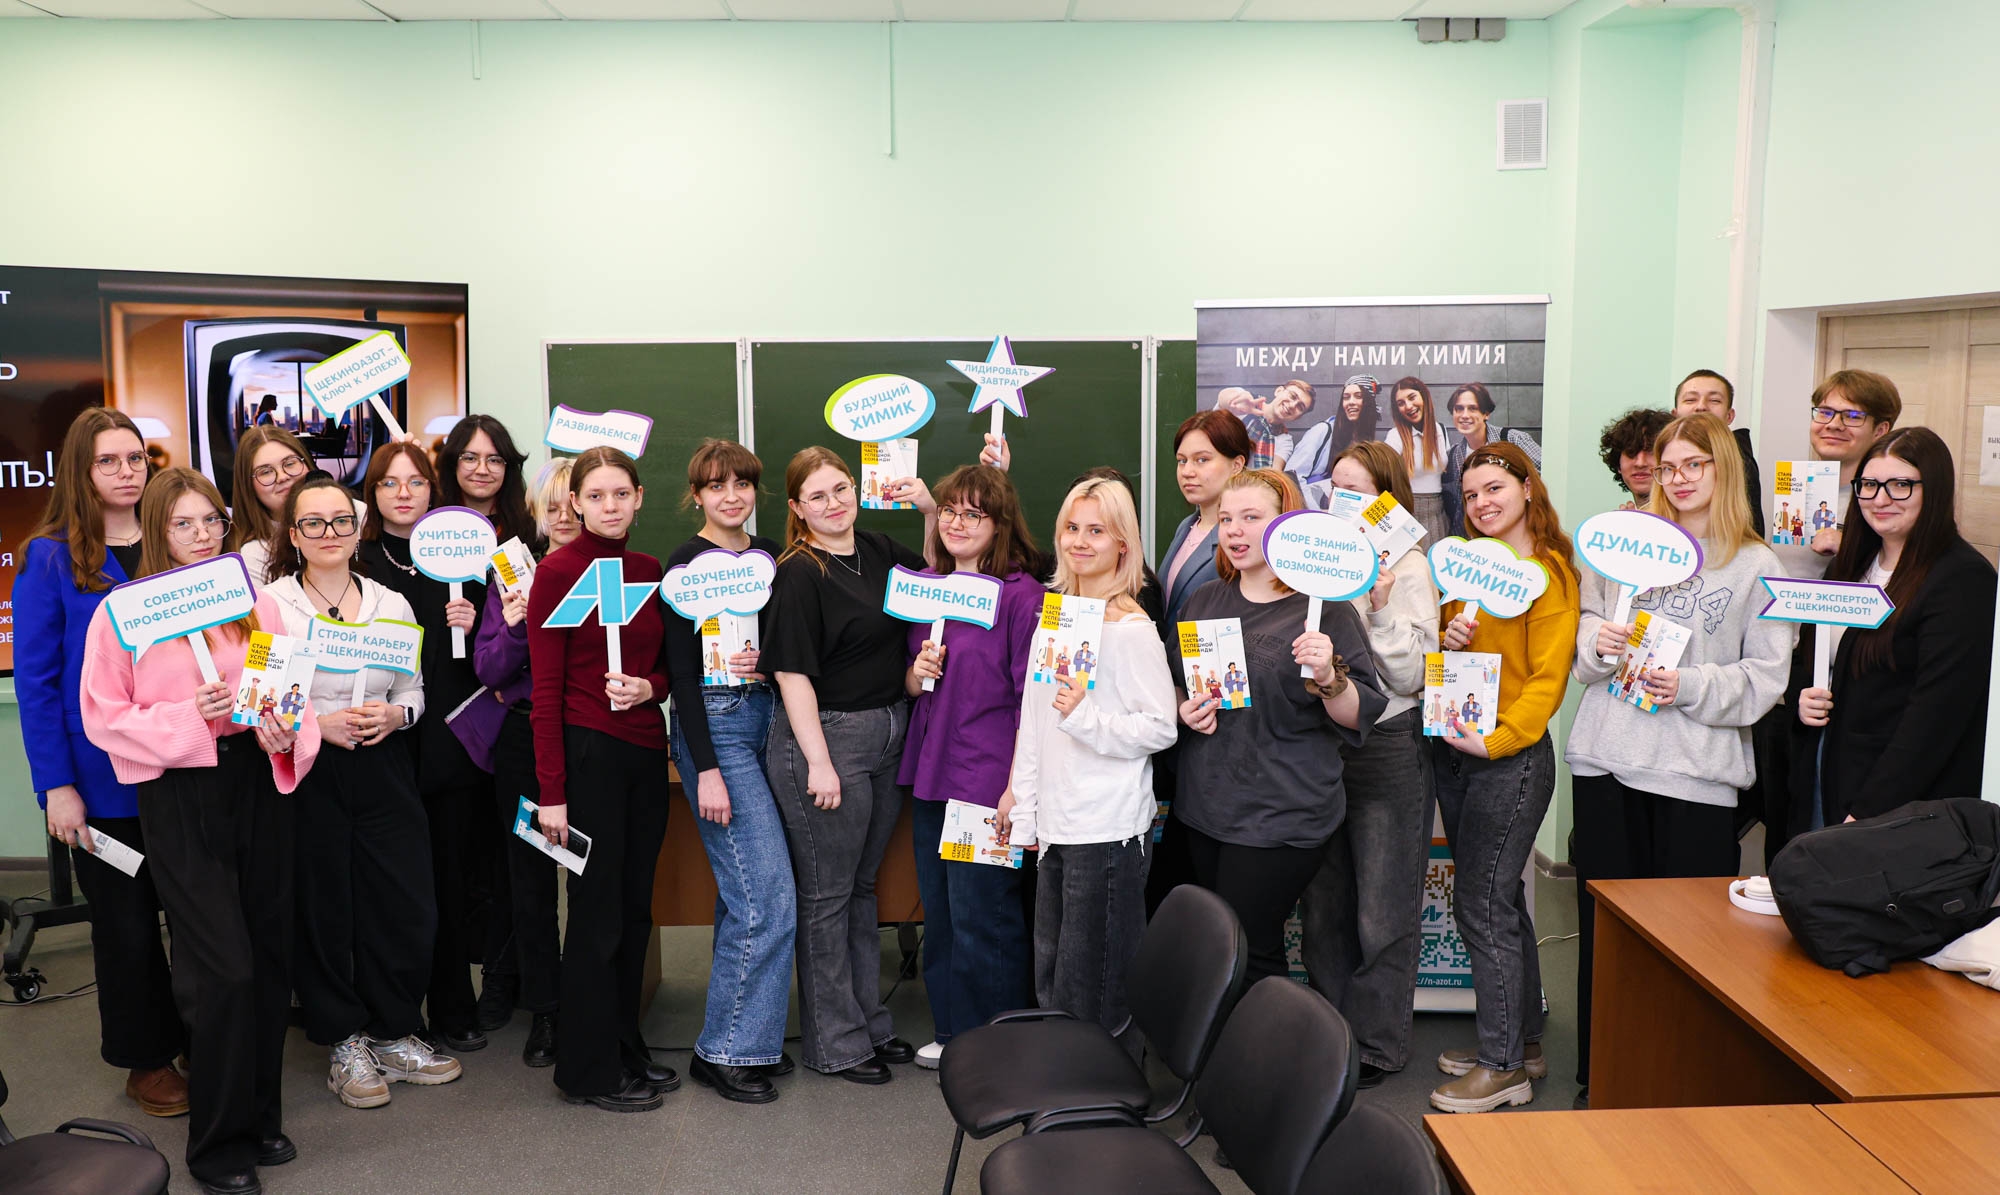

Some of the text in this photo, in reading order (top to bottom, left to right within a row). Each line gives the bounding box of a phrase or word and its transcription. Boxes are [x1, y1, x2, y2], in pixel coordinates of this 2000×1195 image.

[1235, 343, 1506, 371] МЕЖДУ НАМИ ХИМИЯ
[313, 347, 386, 391] ЩЕКИНОАЗОТ
[321, 355, 402, 402] КЛЮЧ К УСПЕХУ!
[964, 364, 1029, 377] ЛИДИРОВАТЬ
[980, 376, 1019, 387] ЗАВТРА!
[844, 382, 911, 414] БУДУЩИЙ
[850, 400, 916, 432] ХИМИК
[556, 418, 642, 443] РАЗВИВАЕМСЯ!
[418, 529, 478, 541] УЧИТЬСЯ
[1280, 532, 1312, 545] МОРЕ
[1314, 537, 1357, 552] ЗНАНИЙ
[418, 546, 485, 558] СЕГОДНЯ!
[1303, 549, 1340, 564] ОКЕАН
[1586, 531, 1690, 566] ДУМАТЬ!
[1276, 558, 1364, 581] ВОЗМОЖНОСТЕЙ
[1447, 545, 1489, 566] МЕЖДУ
[1491, 562, 1524, 580] НАМИ
[681, 566, 755, 586] ОБУЧЕНИЕ
[1440, 557, 1529, 604] ХИМИЯ!
[143, 579, 215, 608] СОВЕТУЮТ
[674, 580, 766, 603] БЕЗ СТРЕССА!
[895, 581, 992, 611] МЕНЯЕМСЯ!
[1779, 590, 1879, 605] СТАНУ ЭКСПЕРТОМ
[123, 586, 247, 631] ПРОФЕССИОНАЛЫ
[1785, 601, 1871, 616] С ЩЕКИНОАЗОТ!
[252, 643, 271, 651] СТАНЬ
[318, 627, 414, 652] СТРОЙ КАРЬЕРУ
[248, 659, 282, 669] КОМАНДЫ
[250, 653, 284, 664] УСПЕШНОЙ
[251, 649, 276, 657] ЧАСТЬЮ
[326, 645, 411, 666] ЩЕКИНОАЗОТ
[1416, 977, 1462, 986] ://n-azot.ru
